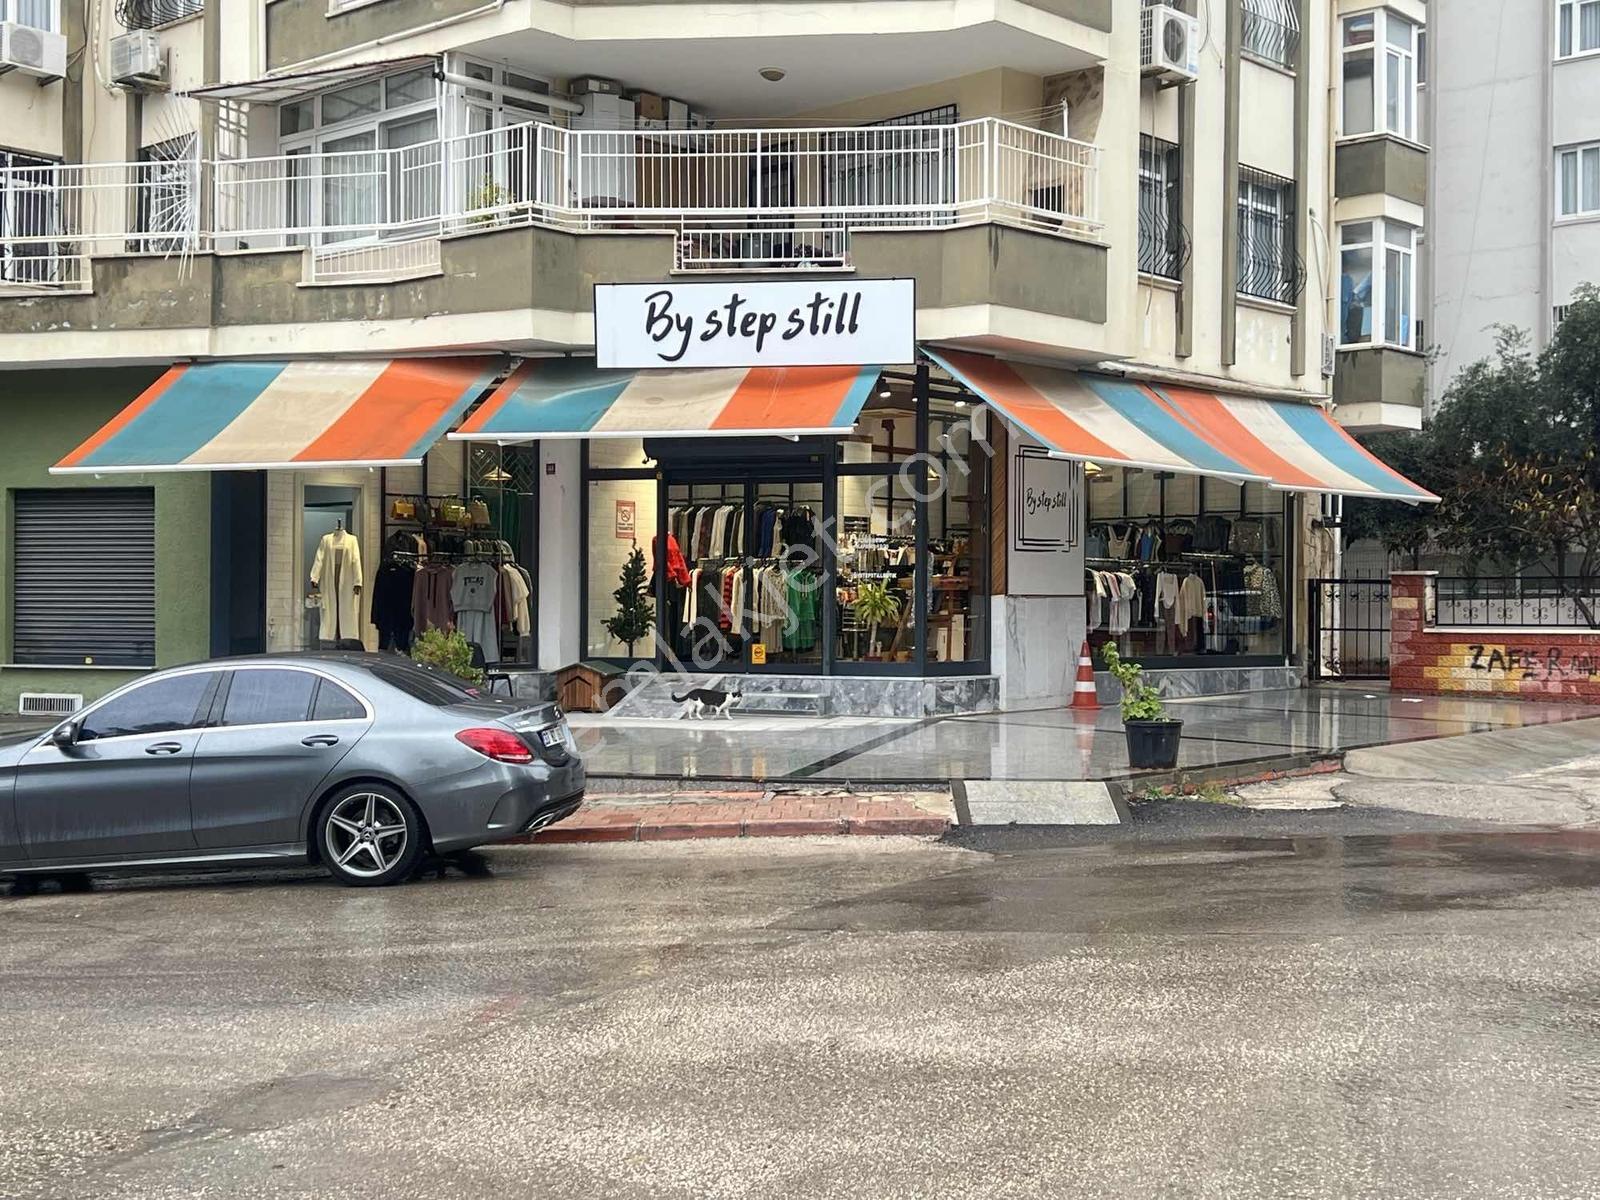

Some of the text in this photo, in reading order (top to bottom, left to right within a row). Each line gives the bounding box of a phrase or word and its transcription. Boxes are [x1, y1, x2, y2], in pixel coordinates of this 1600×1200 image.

[644, 290, 862, 362] By step still
[1026, 487, 1067, 515] By step still
